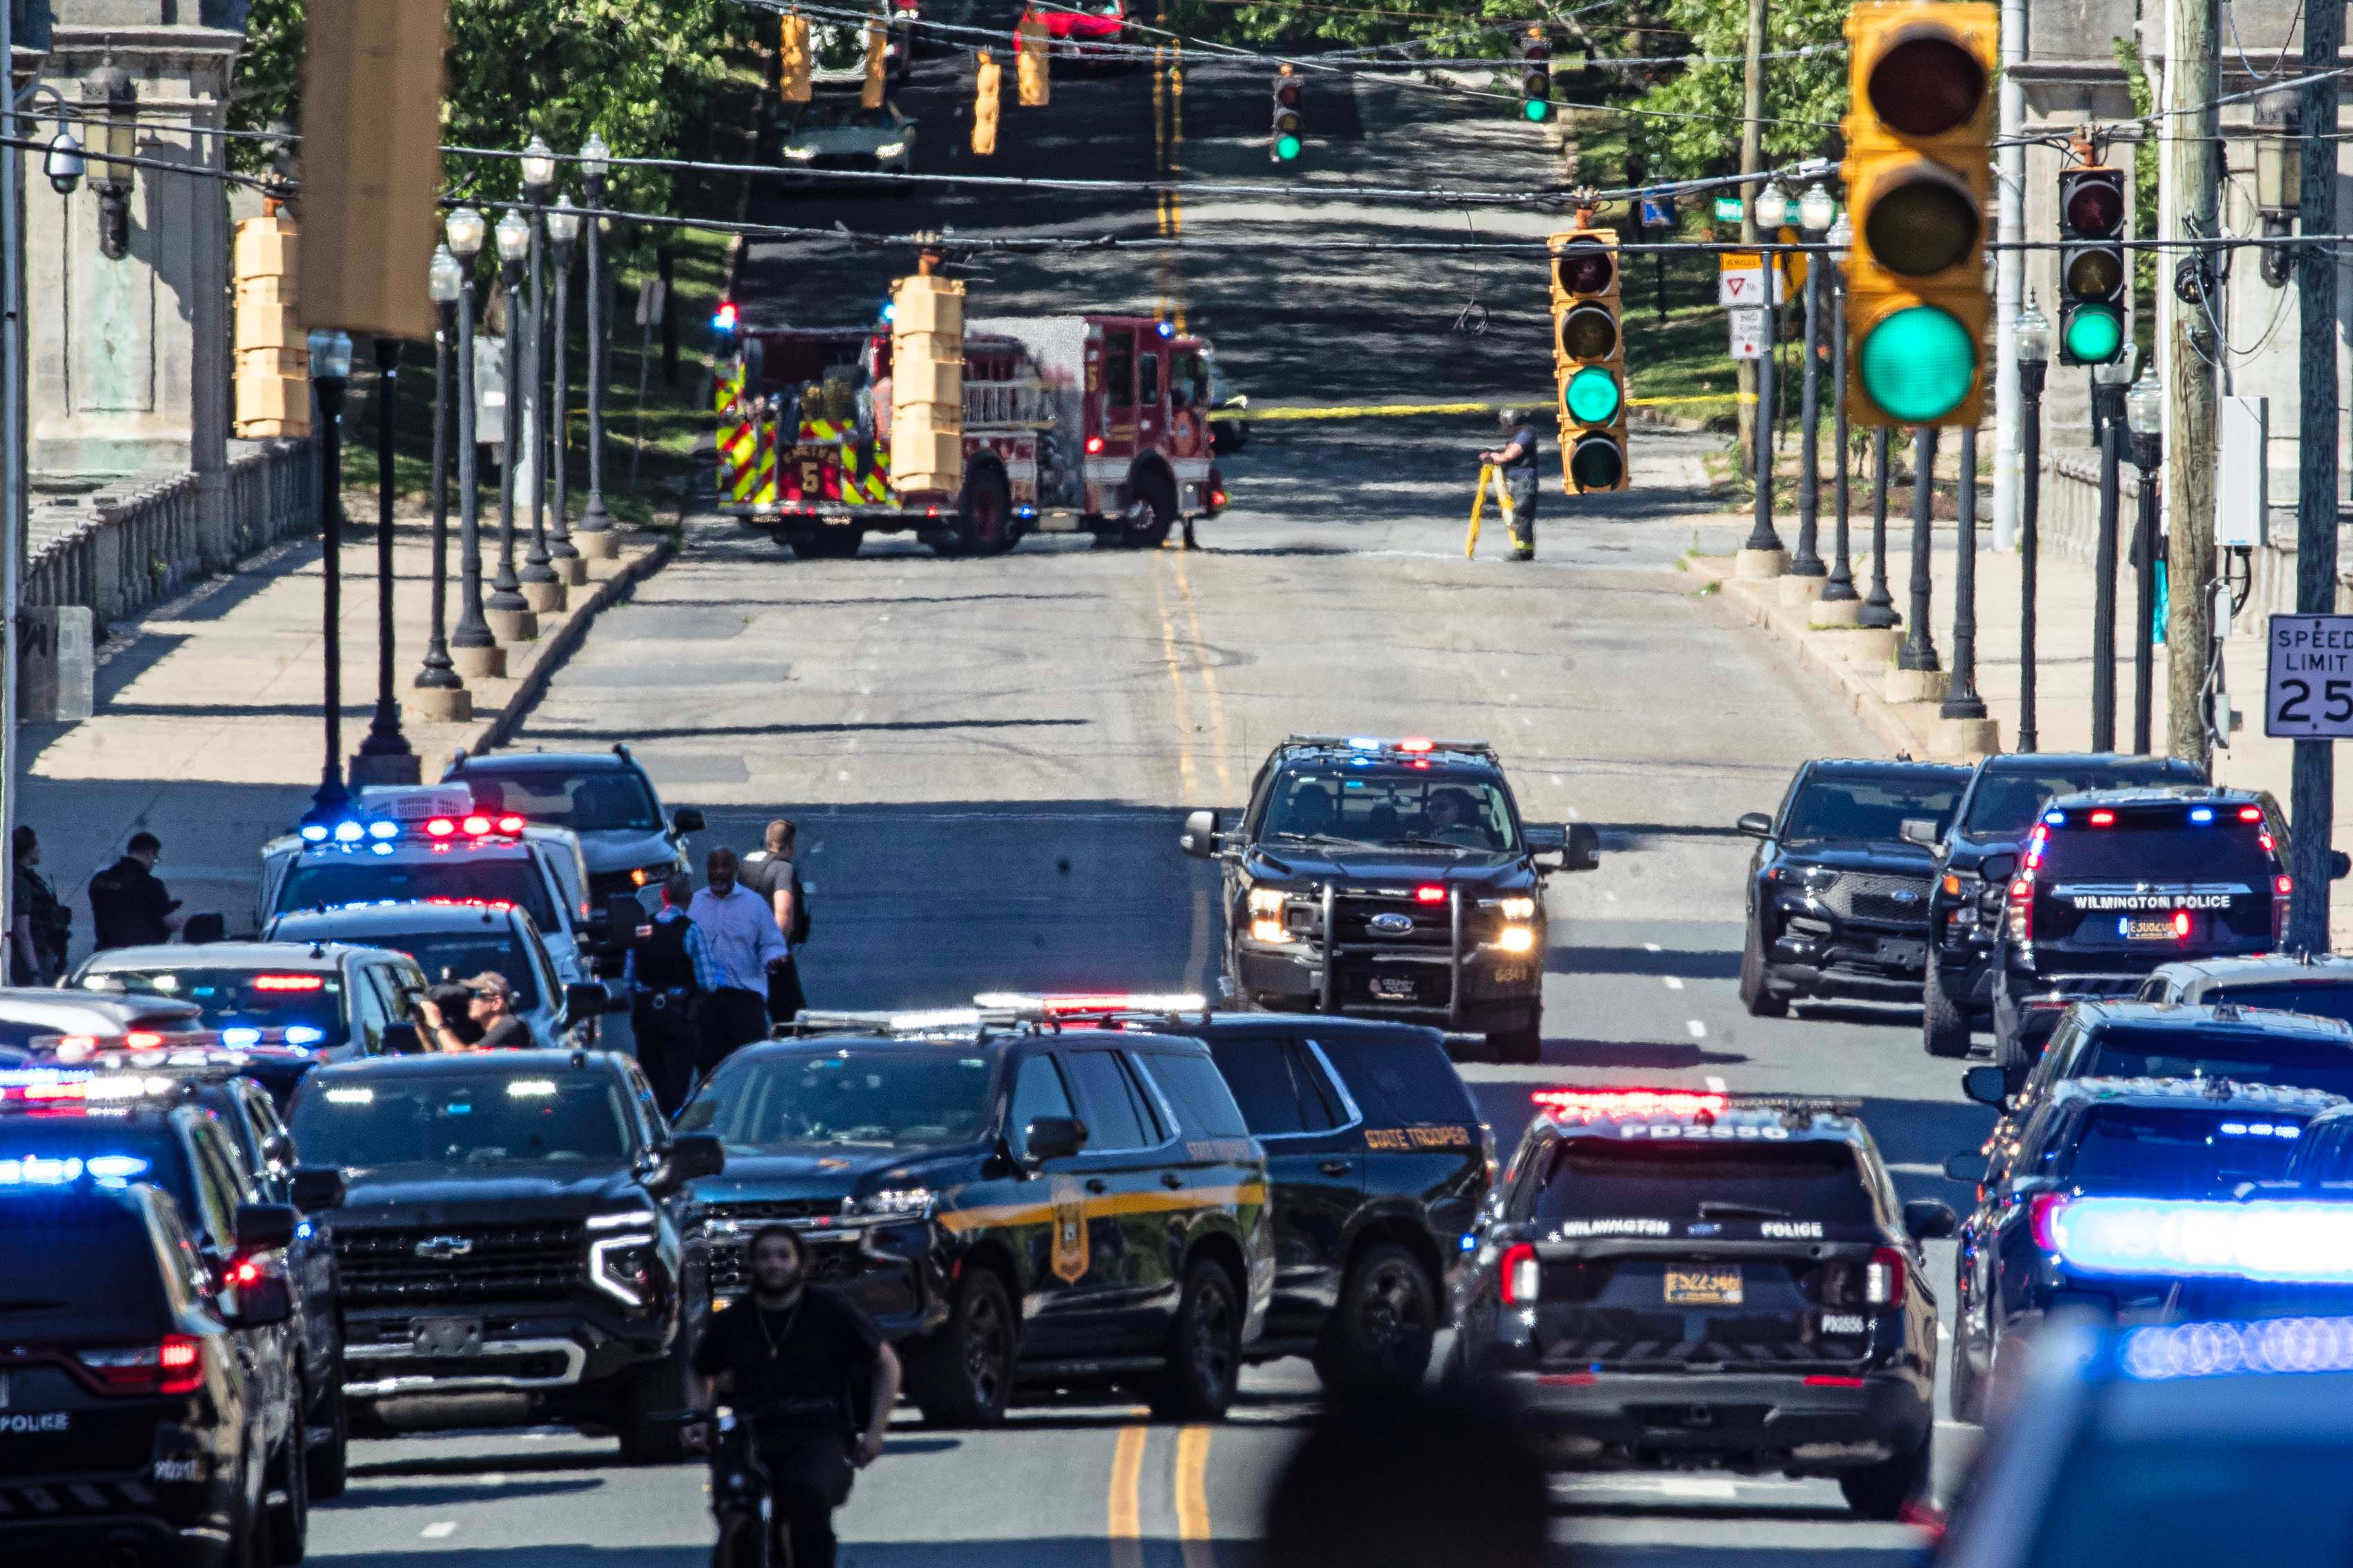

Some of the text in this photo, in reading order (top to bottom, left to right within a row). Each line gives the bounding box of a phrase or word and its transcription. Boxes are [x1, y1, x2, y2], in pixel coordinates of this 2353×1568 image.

[801, 461, 819, 493] 5
[2278, 630, 2353, 649] SPEED
[2285, 652, 2348, 673] LIMIT
[2277, 678, 2353, 722] 25
[2074, 895, 2231, 909] WILMINGTON POLICE
[1365, 1127, 1472, 1149] STATE TROOPER
[1563, 1220, 1823, 1237] WILMINGTON POLICE
[0, 1412, 69, 1432] POLICE
